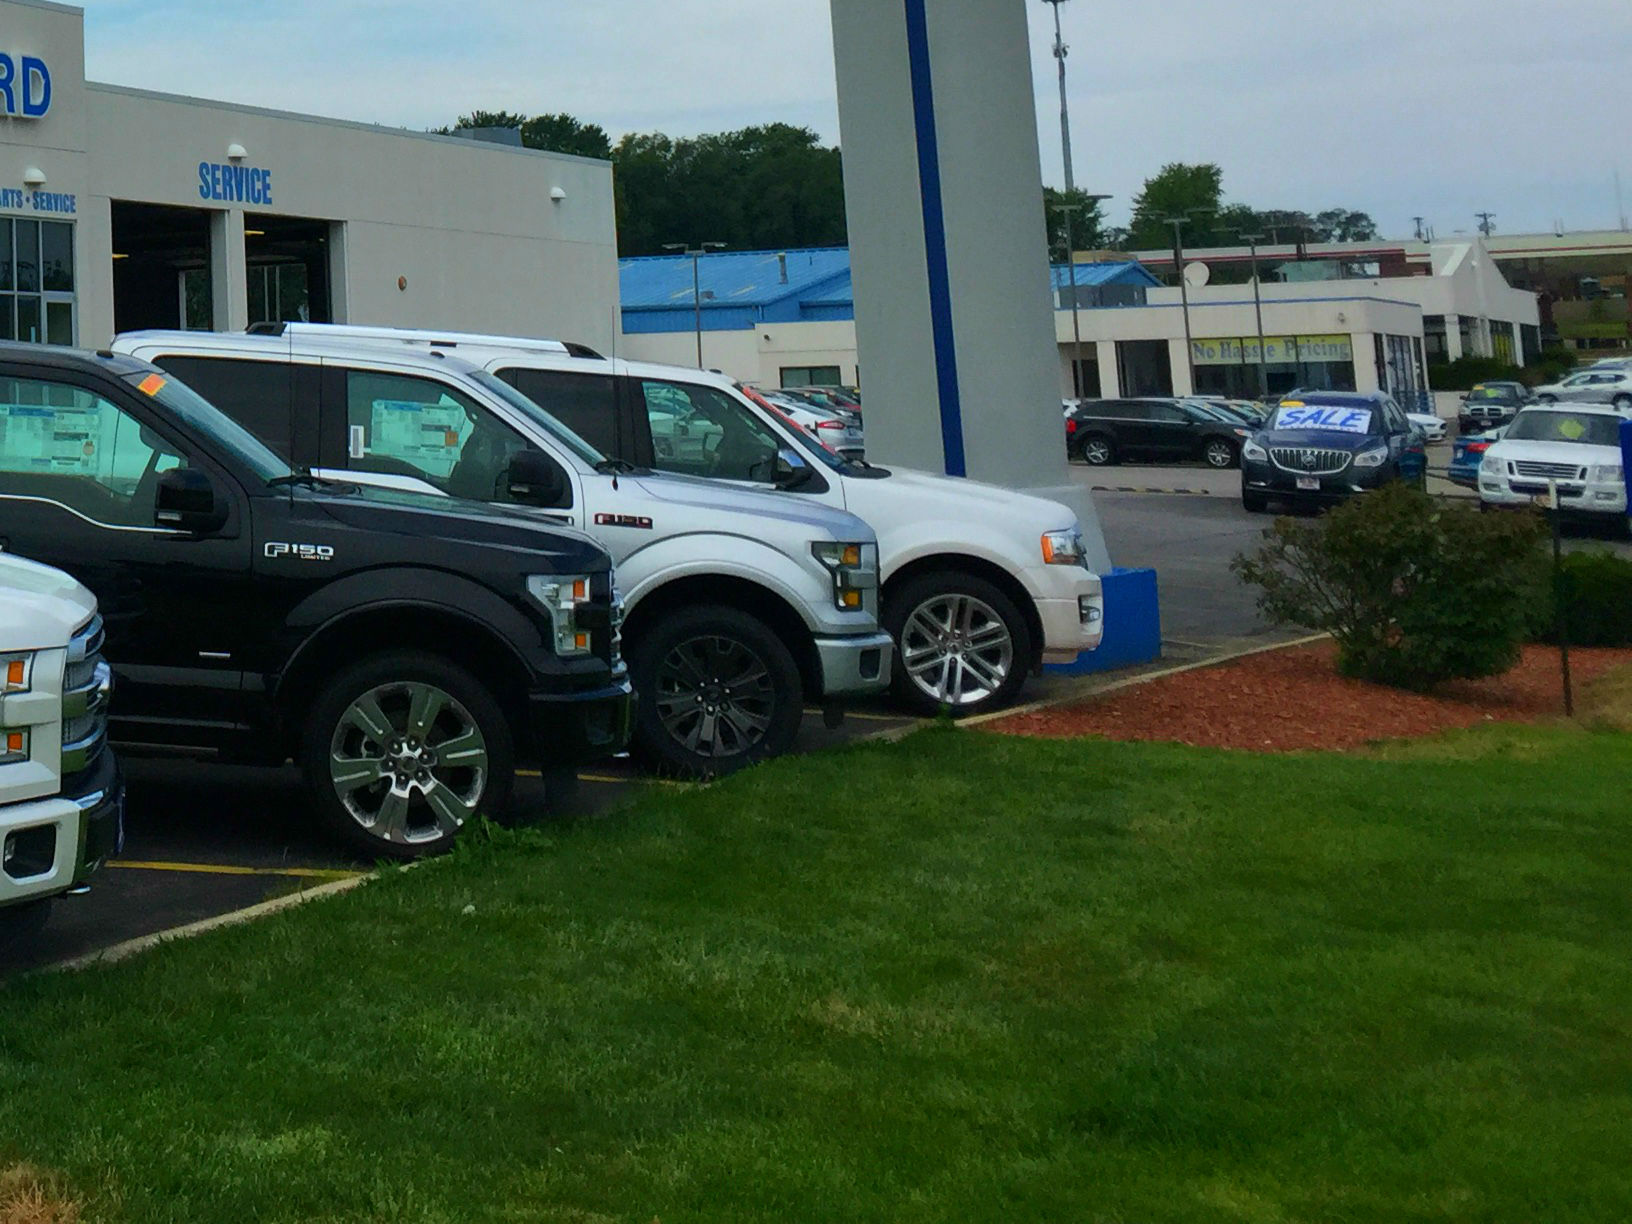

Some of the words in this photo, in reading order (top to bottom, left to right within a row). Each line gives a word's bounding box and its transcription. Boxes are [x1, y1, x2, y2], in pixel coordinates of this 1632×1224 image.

[198, 162, 273, 205] SERVICE
[32, 191, 76, 214] SERVICE
[1193, 342, 1216, 359] No
[1282, 338, 1349, 360] Pricing
[1278, 409, 1367, 428] SALE
[264, 542, 334, 557] F150
